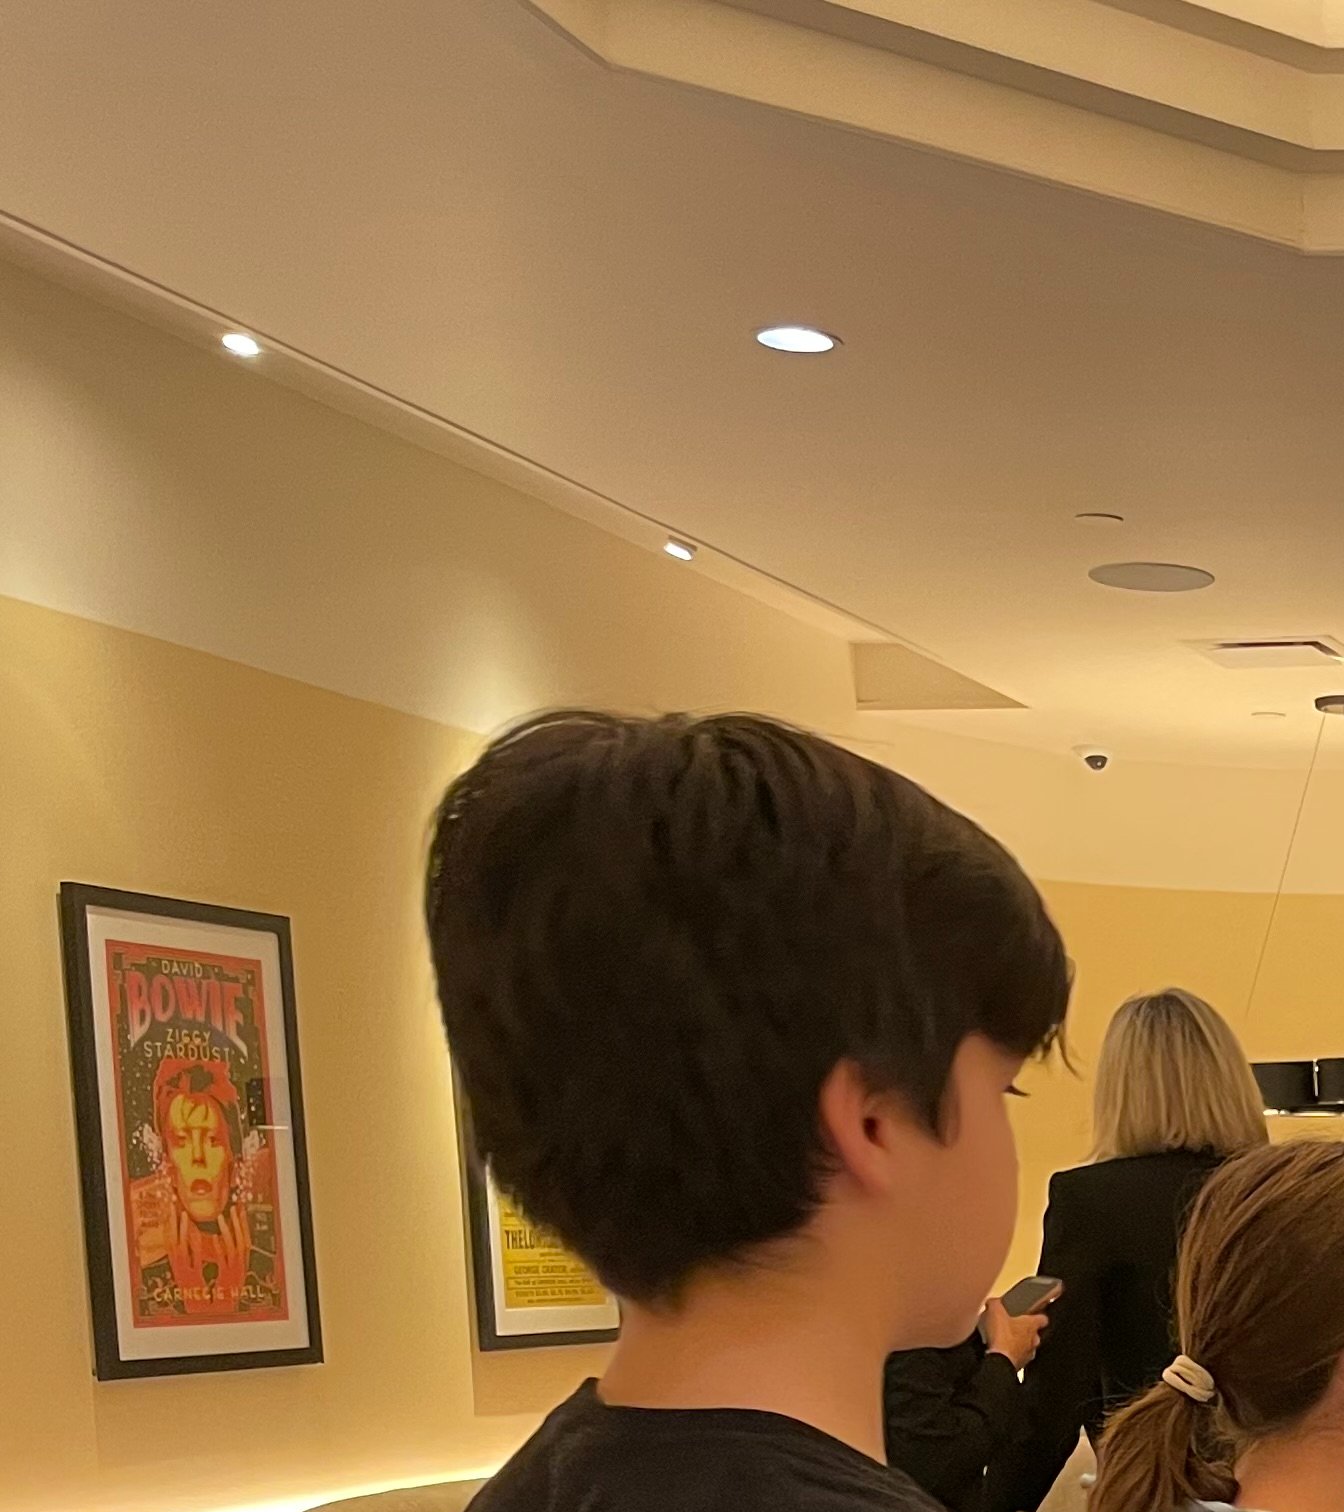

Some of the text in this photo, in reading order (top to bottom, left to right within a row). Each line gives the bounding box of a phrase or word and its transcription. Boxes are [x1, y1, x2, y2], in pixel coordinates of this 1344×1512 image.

[161, 960, 204, 978] DAVID
[126, 971, 249, 1059] BOWIE
[167, 1028, 212, 1046] ZIGGY
[143, 1040, 230, 1063] STARDUST
[153, 1285, 266, 1302] CARNEGIE HALL
